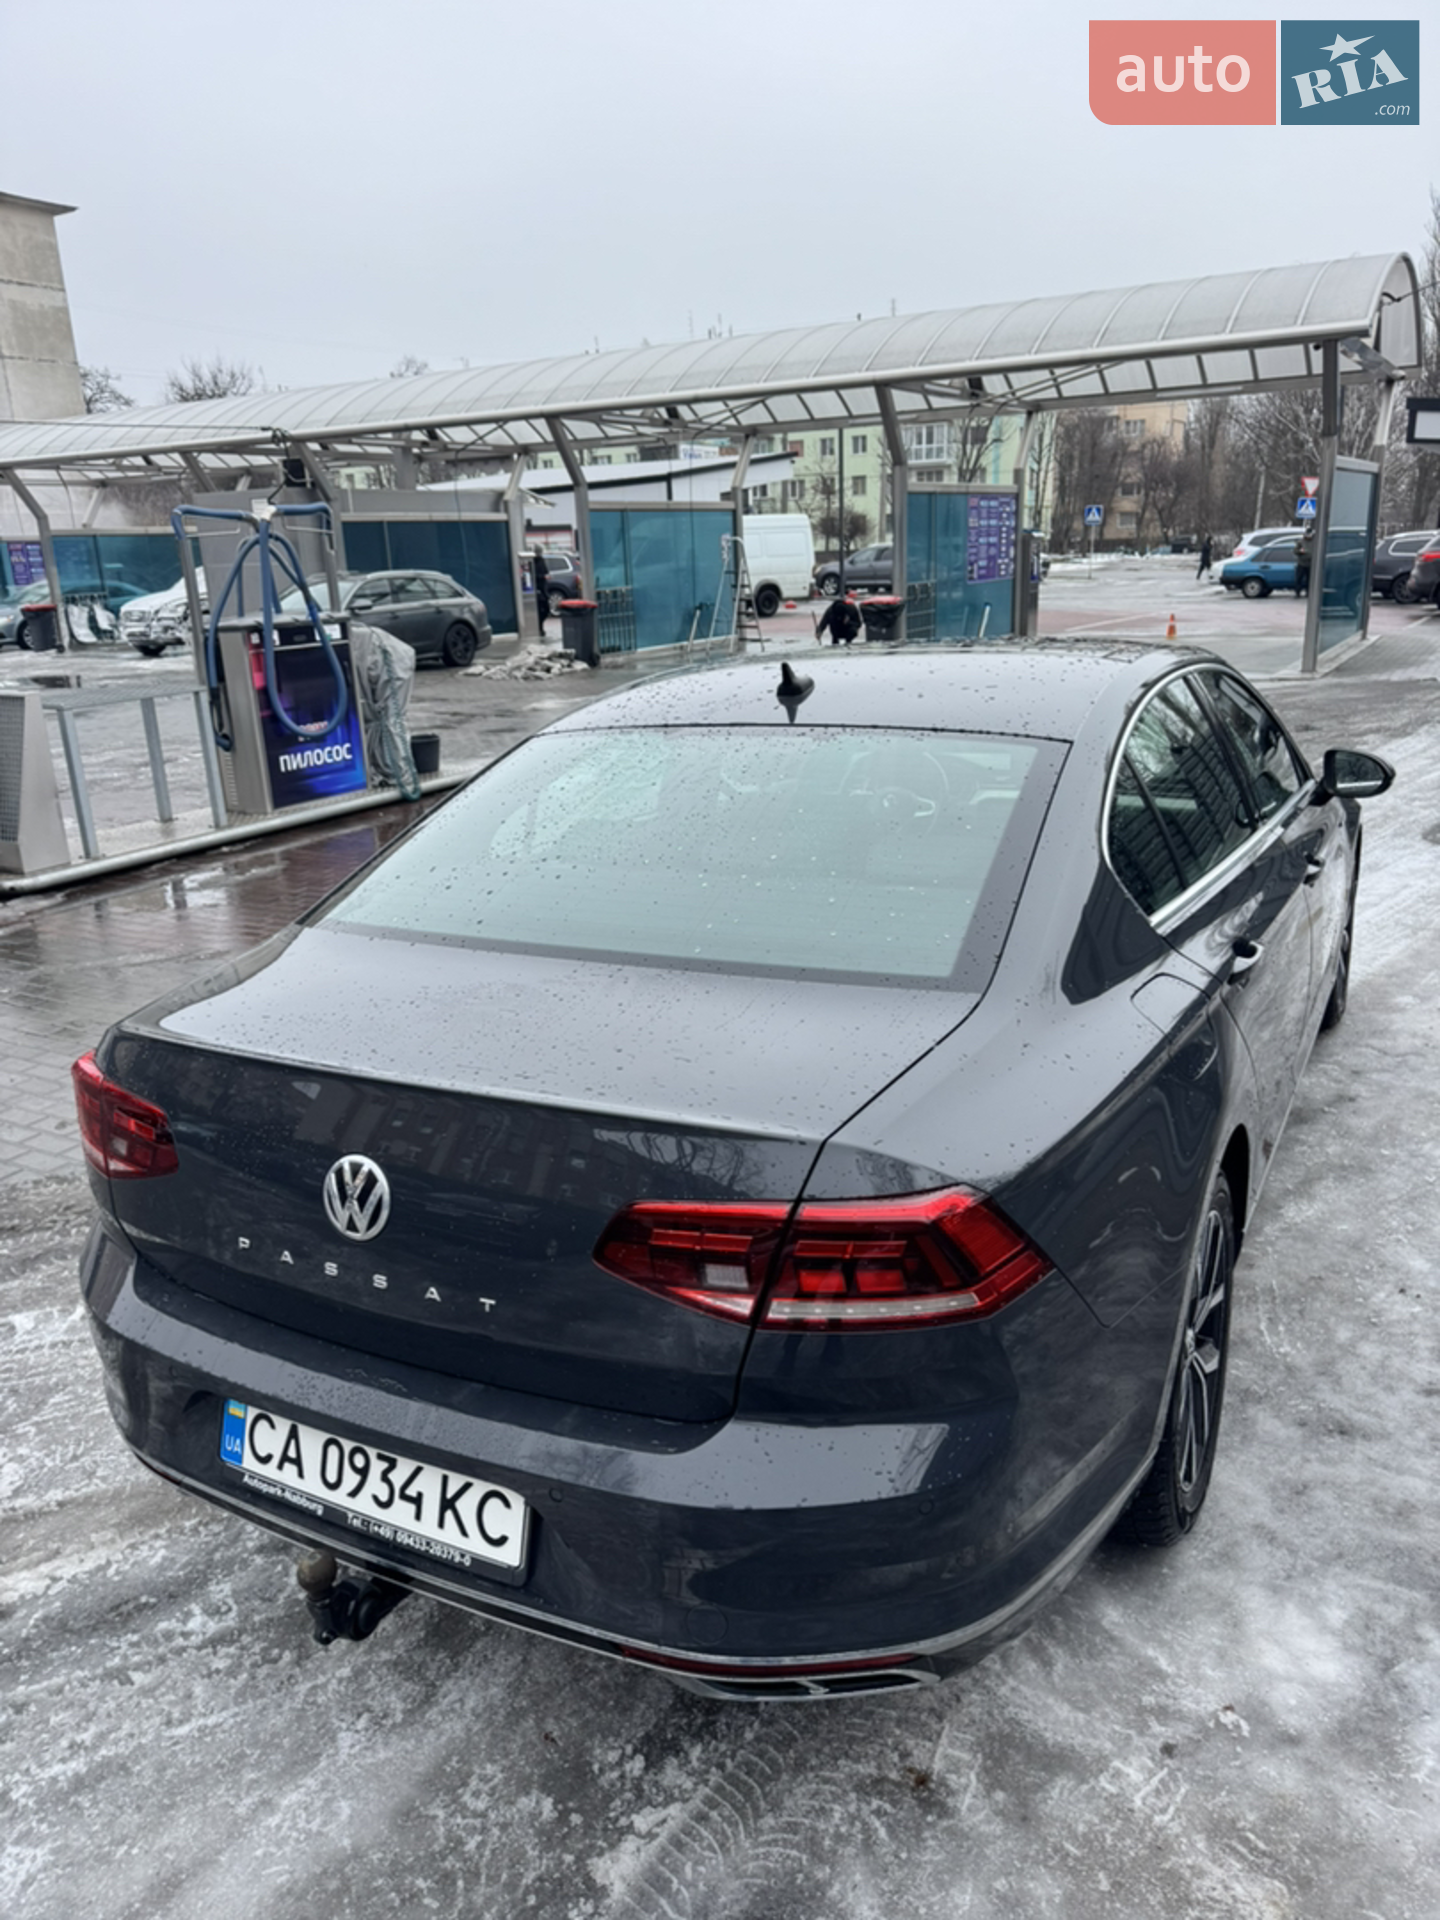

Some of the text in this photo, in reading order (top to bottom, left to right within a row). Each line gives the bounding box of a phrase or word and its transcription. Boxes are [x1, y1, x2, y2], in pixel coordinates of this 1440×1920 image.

[279, 743, 353, 773] ПИЛОСОС
[238, 1236, 496, 1313] PASSAT
[225, 1433, 242, 1455] UA
[248, 1412, 513, 1547] CA 0934 KC
